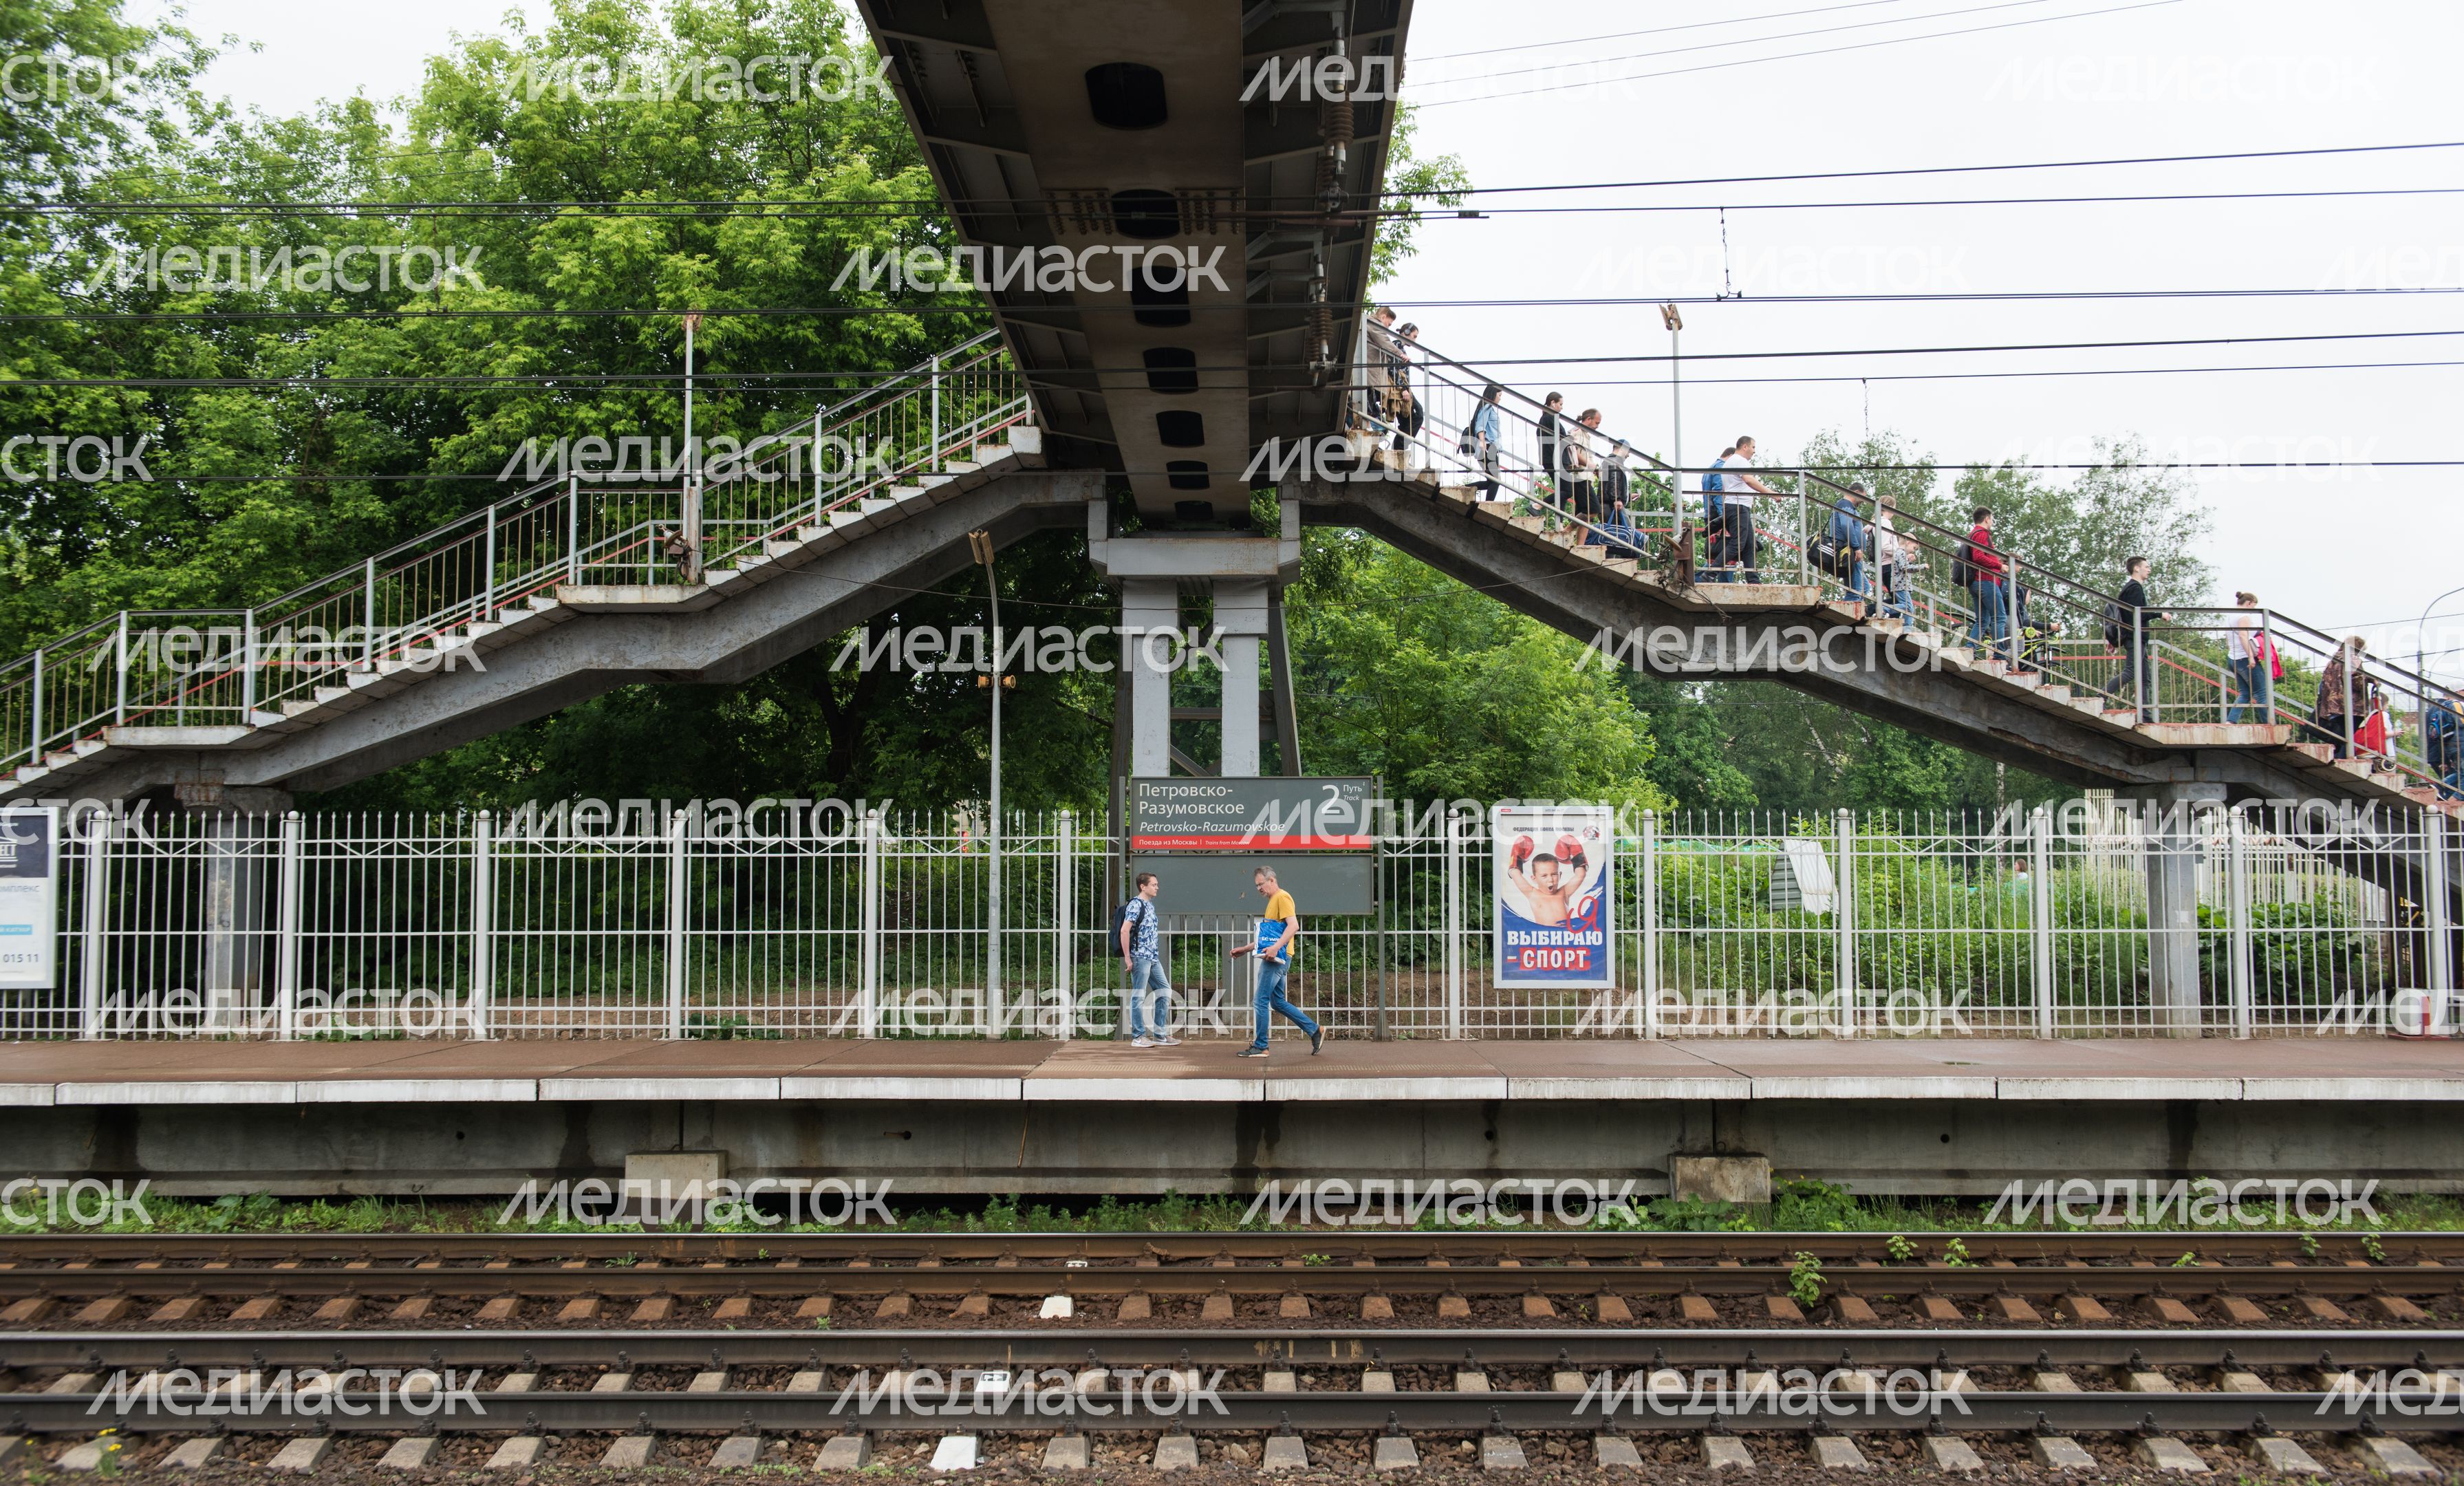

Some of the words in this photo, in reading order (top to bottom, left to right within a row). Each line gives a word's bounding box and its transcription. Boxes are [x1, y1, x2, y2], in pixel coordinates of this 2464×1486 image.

[1139, 784, 1233, 800] Петровско-
[1343, 784, 1363, 793] Путь
[1321, 784, 1340, 814] 2
[1139, 801, 1245, 818] Разумовское
[1139, 821, 1285, 832] Petrovsko-Razumovskoe
[1507, 930, 1603, 946] ВЫБИРАЮ
[3, 954, 23, 963] 015
[27, 954, 39, 963] 11
[1522, 949, 1586, 968] СПОРТ
